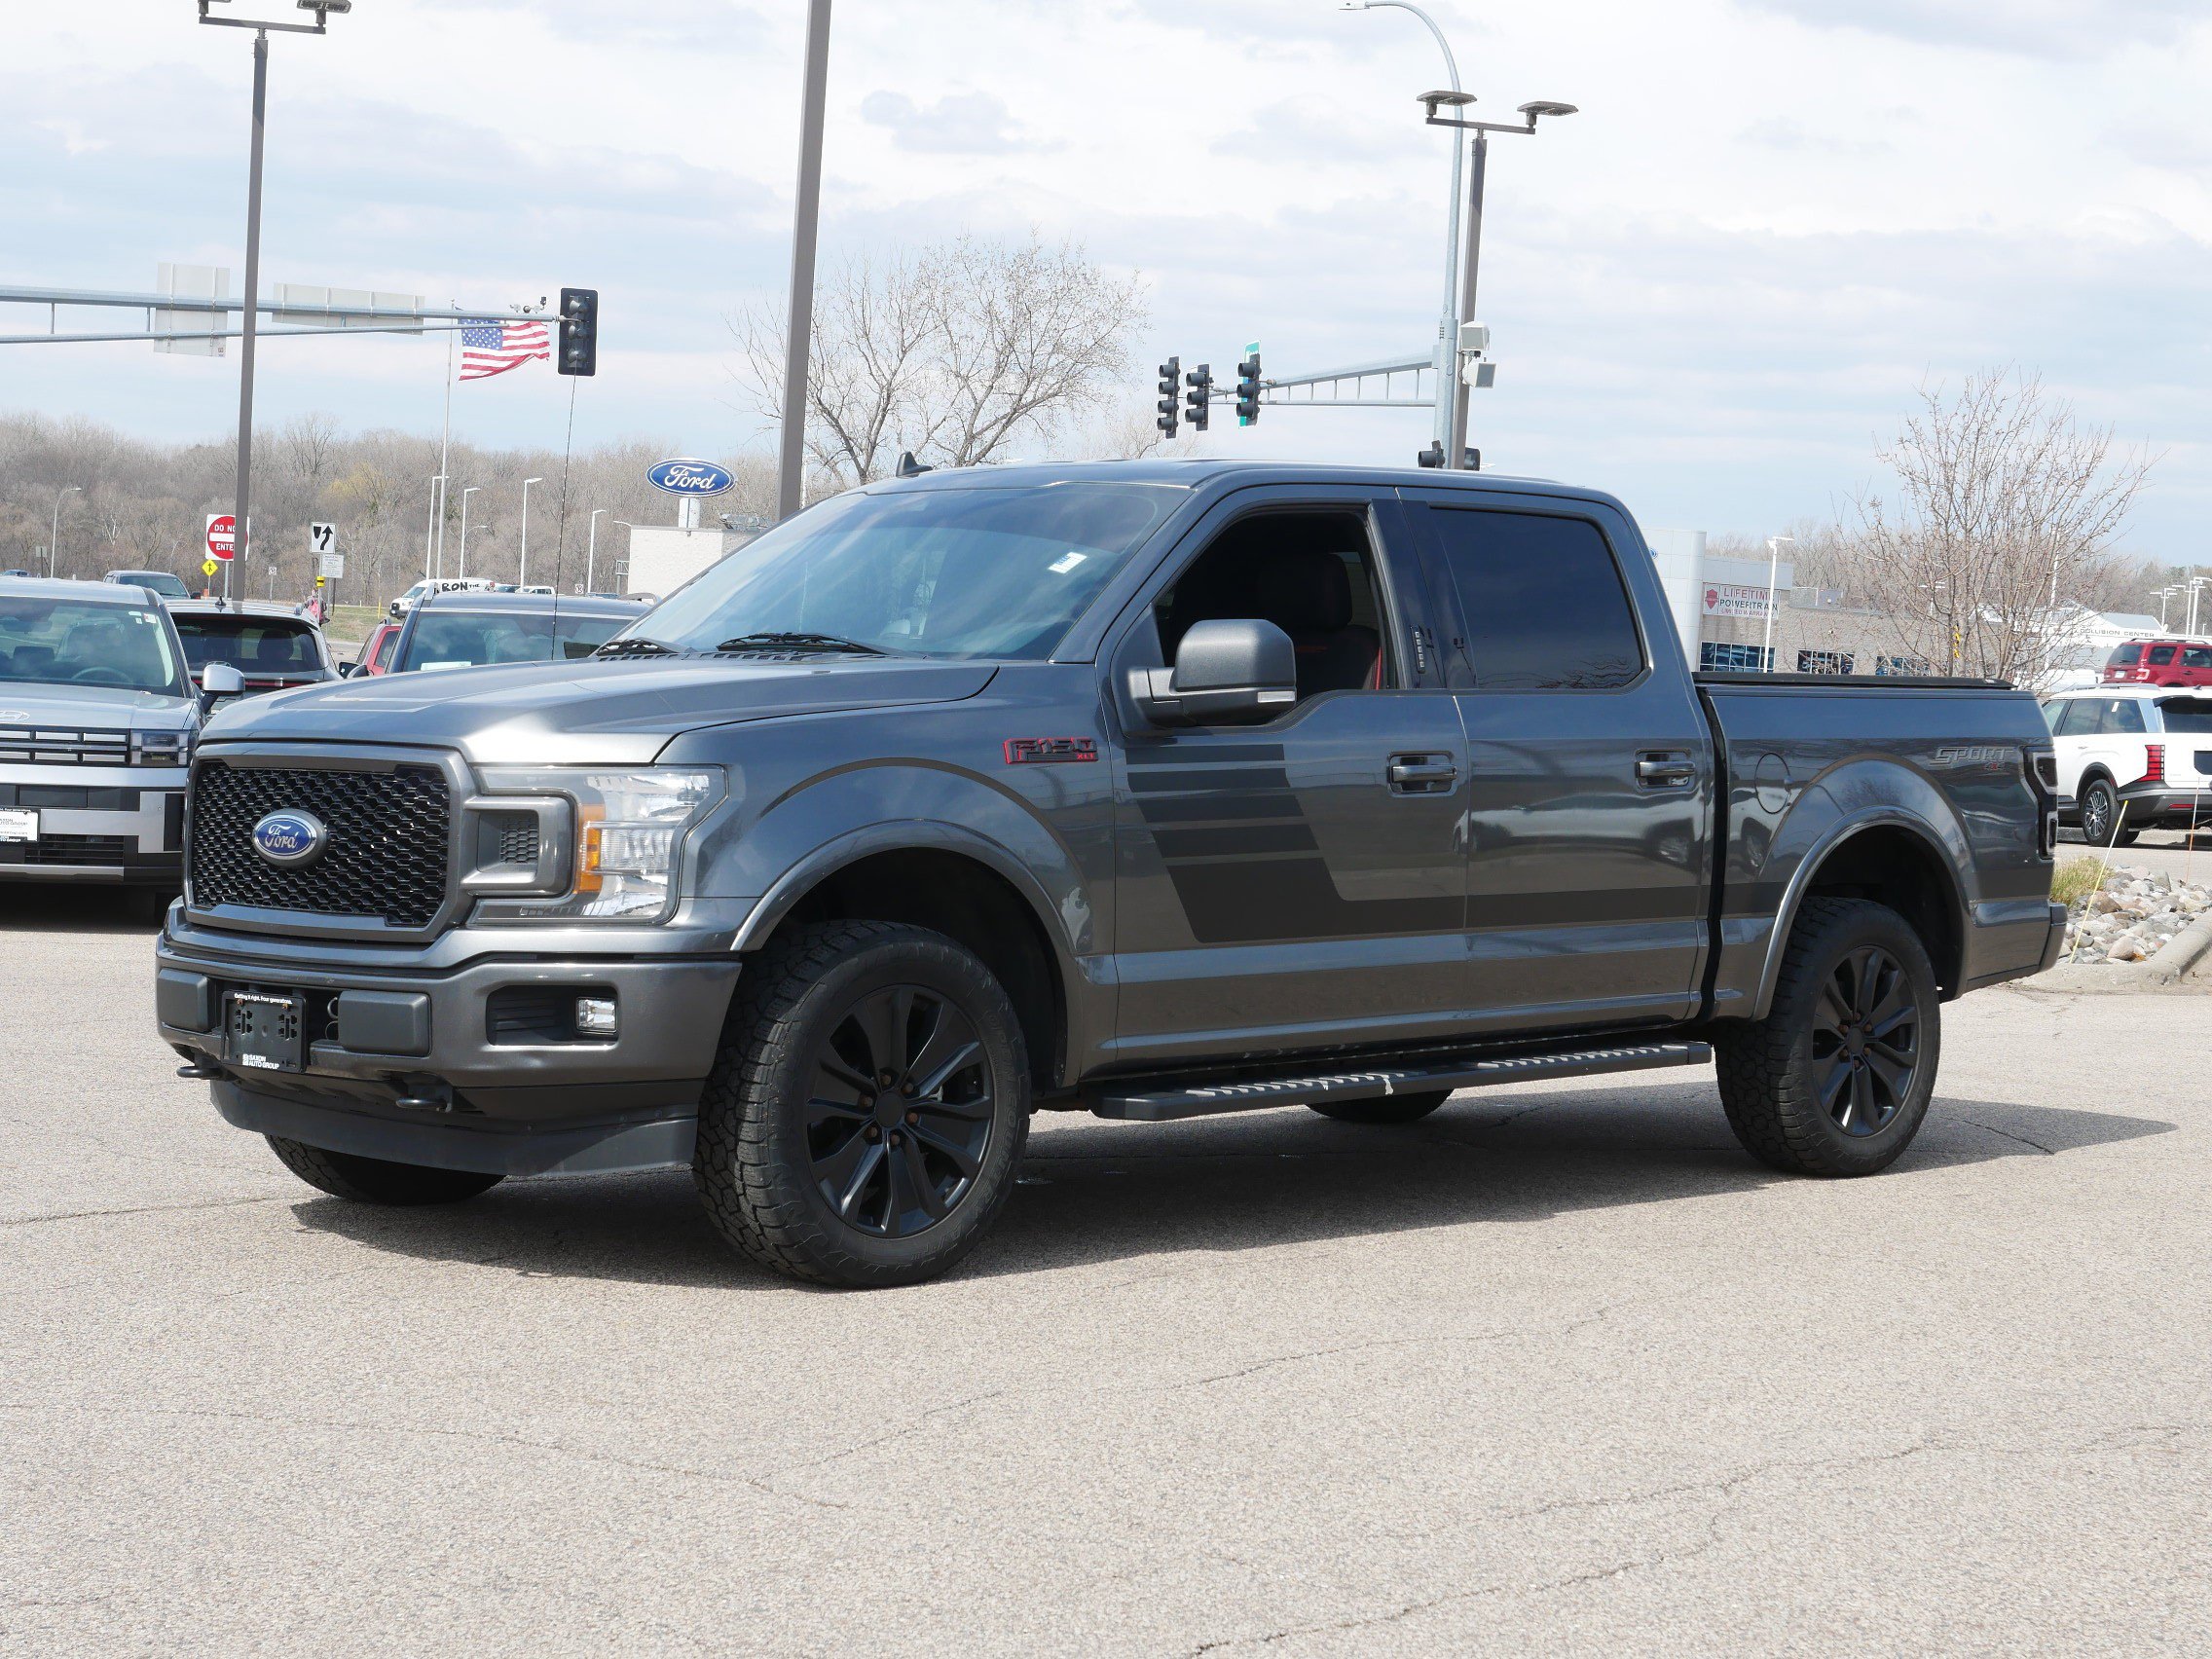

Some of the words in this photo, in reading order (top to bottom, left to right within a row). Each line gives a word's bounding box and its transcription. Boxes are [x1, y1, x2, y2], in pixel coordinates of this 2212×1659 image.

[664, 464, 717, 489] Ford
[214, 524, 225, 533] DO
[441, 581, 468, 592] RON
[1719, 599, 1778, 610] POWERTRAN
[1929, 746, 2016, 767] SPORT
[264, 824, 299, 849] Ford
